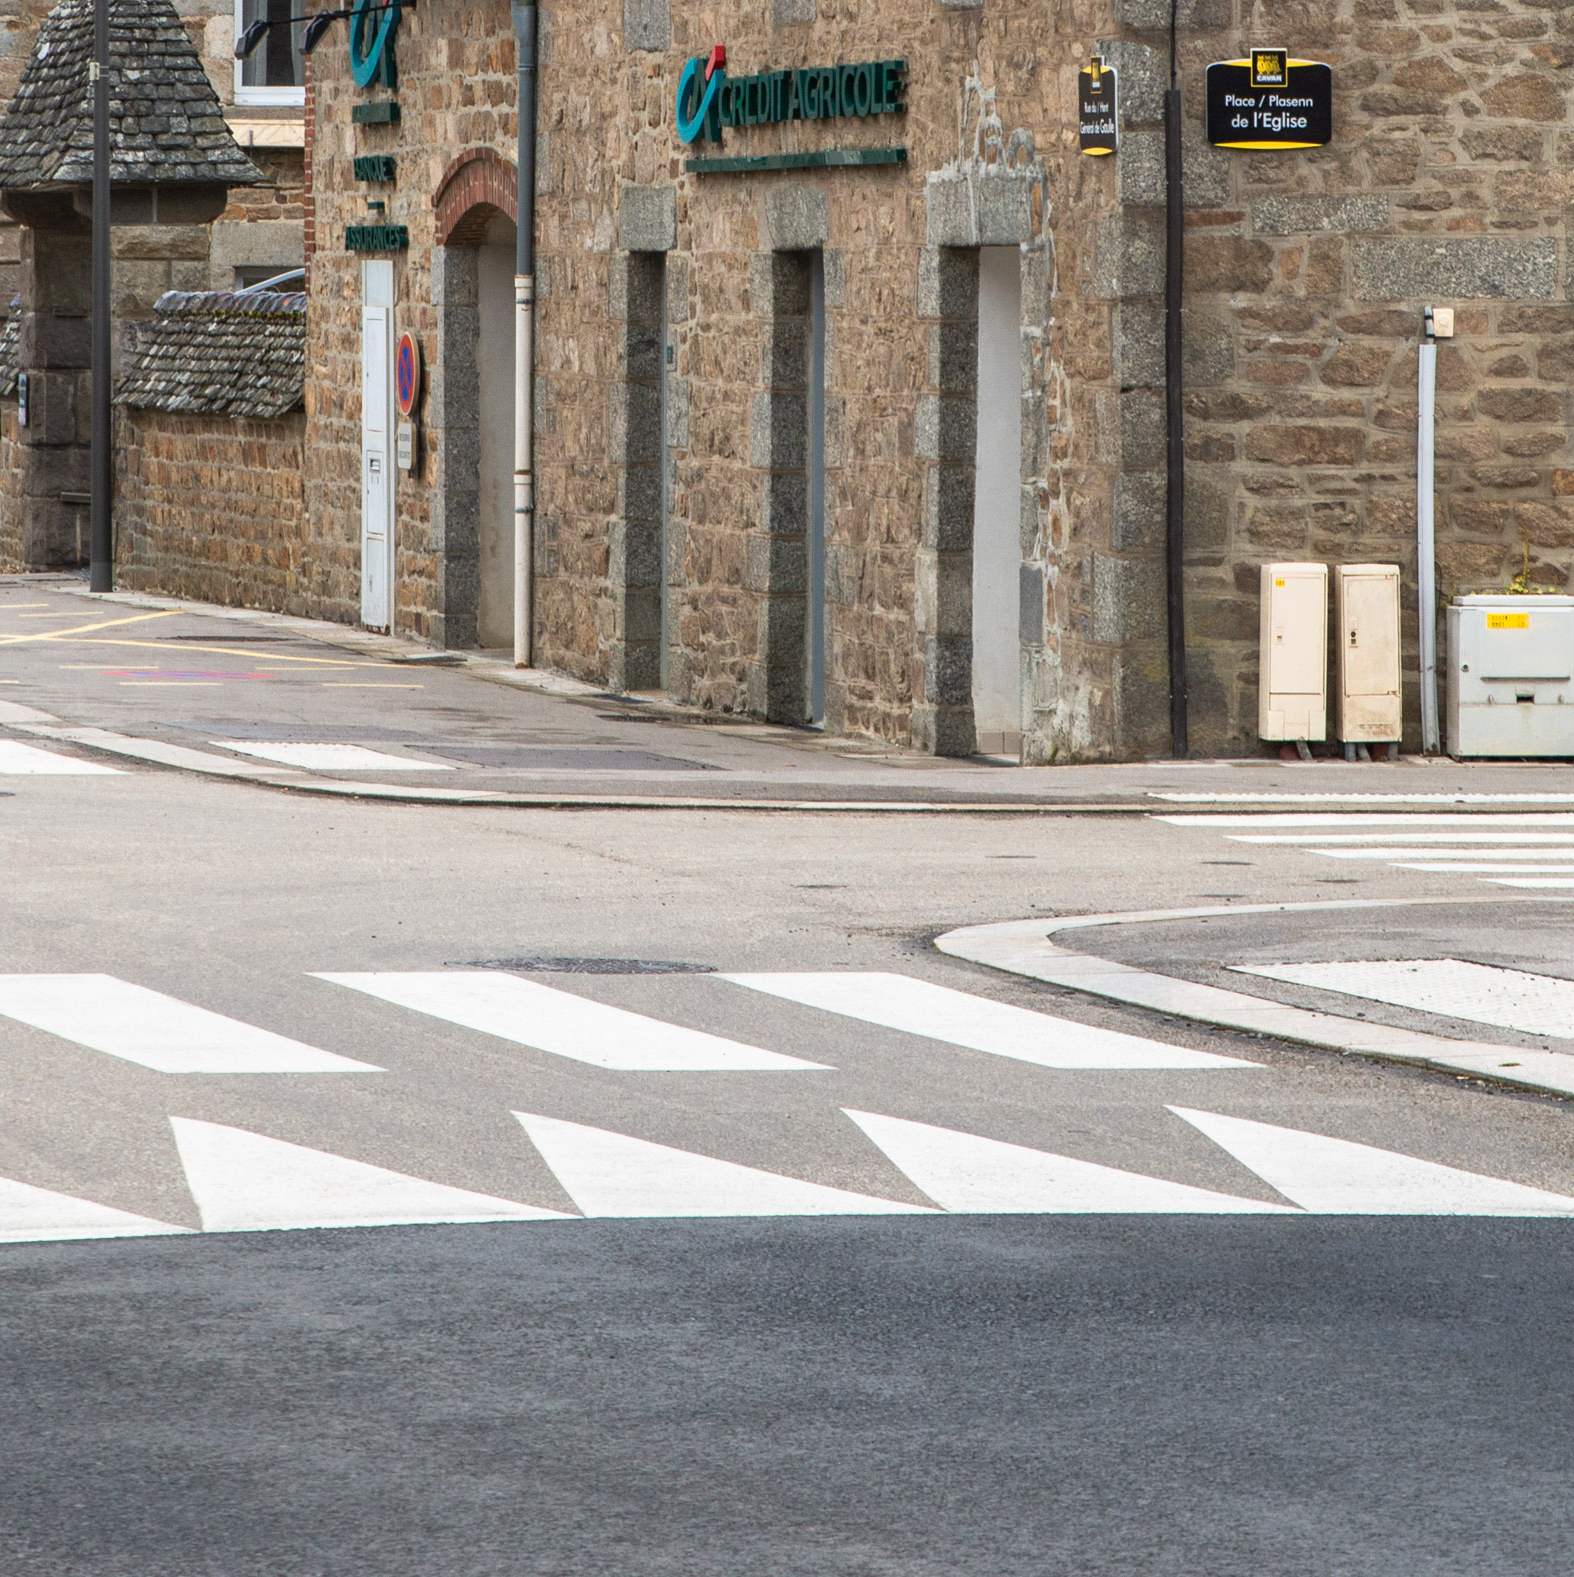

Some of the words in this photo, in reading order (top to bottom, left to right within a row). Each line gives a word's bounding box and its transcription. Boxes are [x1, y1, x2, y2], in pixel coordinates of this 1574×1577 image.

[788, 60, 908, 120] AGRICOLE
[1225, 94, 1255, 107] Place
[1269, 94, 1313, 107] Plasenn
[1231, 113, 1249, 128] de
